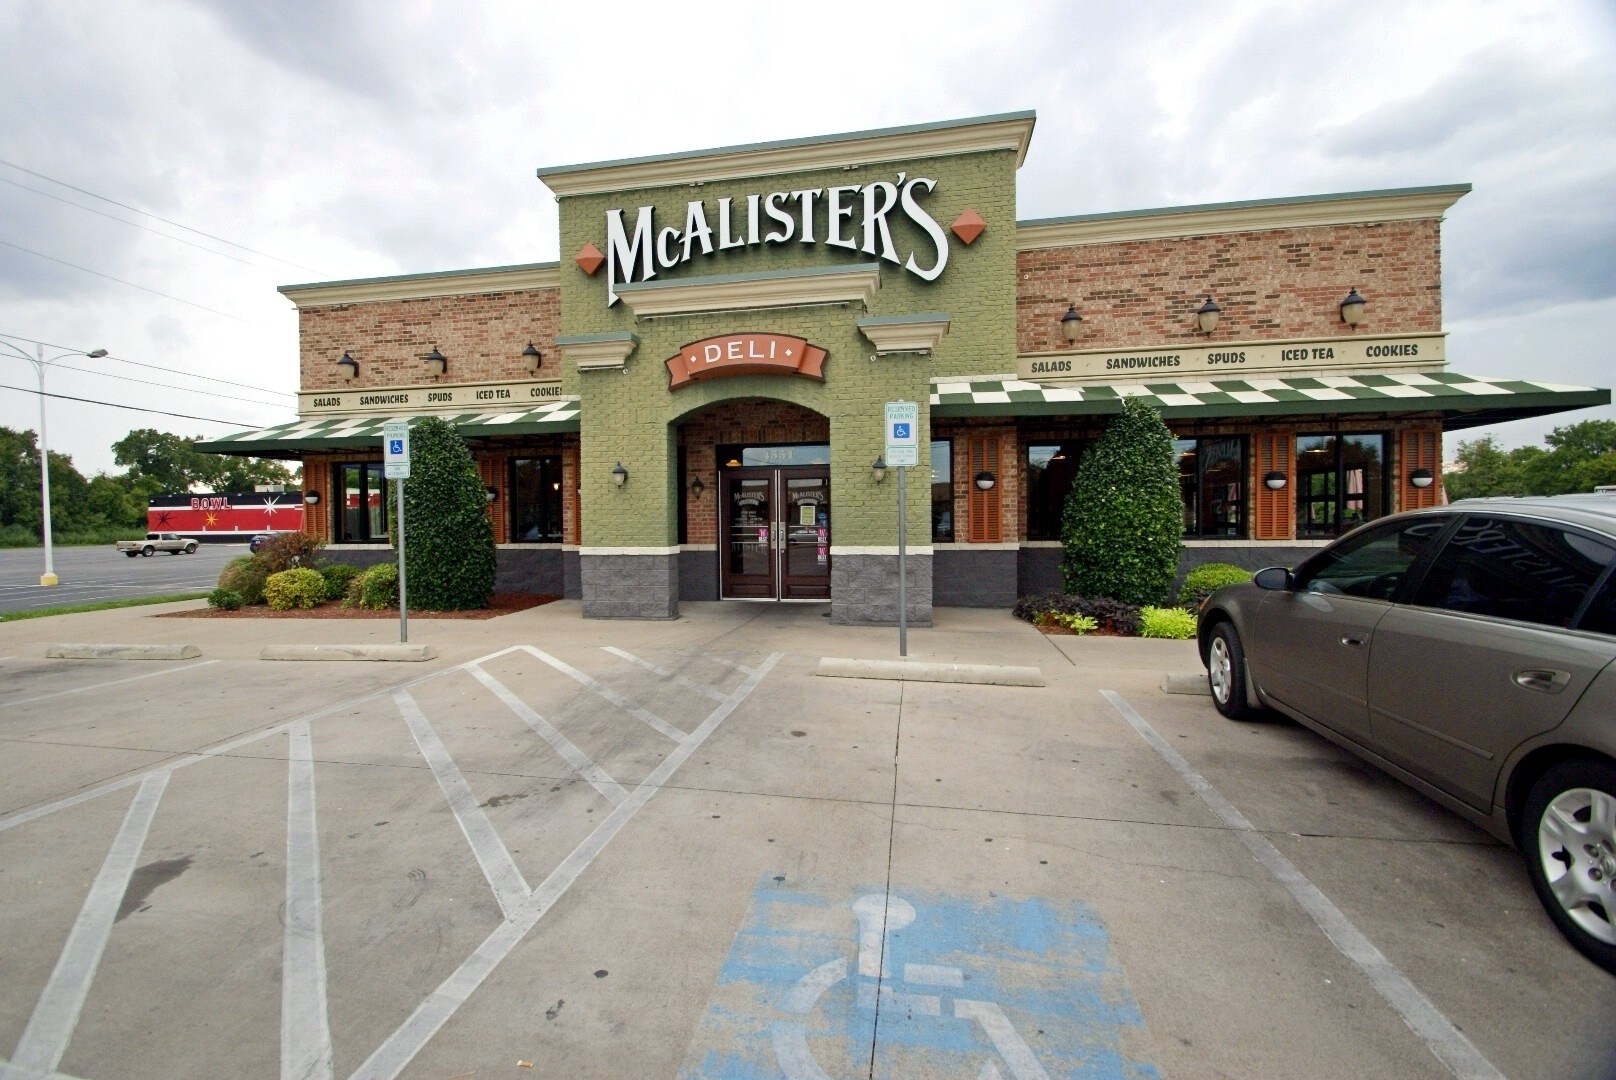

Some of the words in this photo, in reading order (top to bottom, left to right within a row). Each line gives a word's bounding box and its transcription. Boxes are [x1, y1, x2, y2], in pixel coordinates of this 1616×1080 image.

[704, 341, 776, 364] DELI
[1031, 360, 1072, 373] SALADS
[1106, 355, 1181, 370] SANDWICHES
[1207, 352, 1246, 364] SPUDS
[1281, 349, 1308, 361] ICED
[1311, 347, 1334, 359] TEA
[1366, 344, 1418, 358] COOKIES
[313, 397, 341, 407] SALADS
[359, 394, 409, 405] SANDWICHES
[427, 392, 453, 402] SPUDS
[476, 390, 494, 400] ICED
[495, 389, 511, 399] TEA
[887, 405, 916, 413] RESERVED
[191, 497, 232, 510] BOWL
